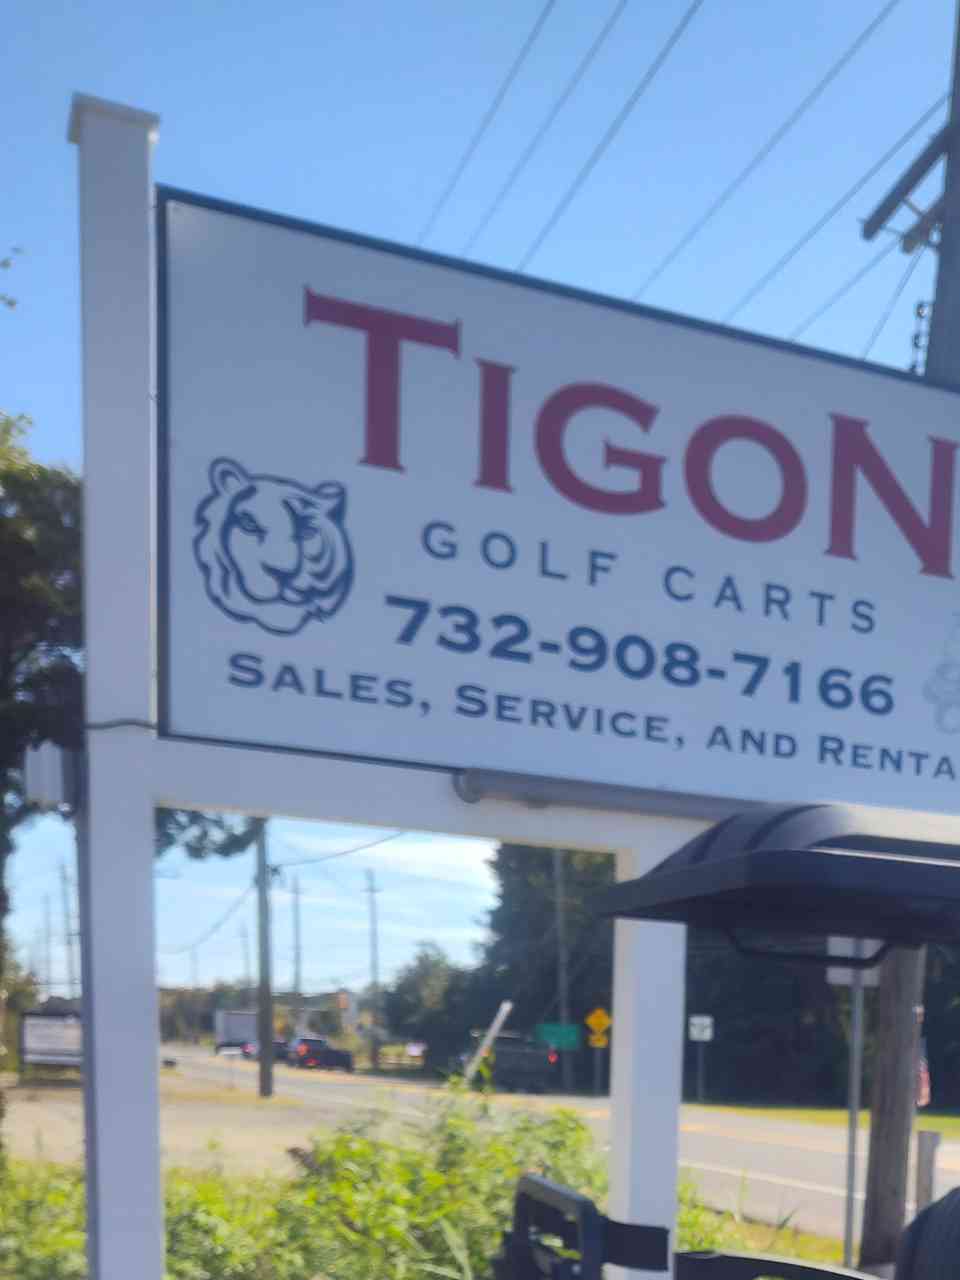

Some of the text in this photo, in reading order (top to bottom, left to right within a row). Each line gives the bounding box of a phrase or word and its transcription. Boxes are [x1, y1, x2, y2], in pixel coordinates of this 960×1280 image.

[302, 285, 960, 581] TIGON
[420, 519, 877, 635] GOLF CARTS
[383, 593, 896, 717] 732-908-7166
[705, 724, 799, 760] AND
